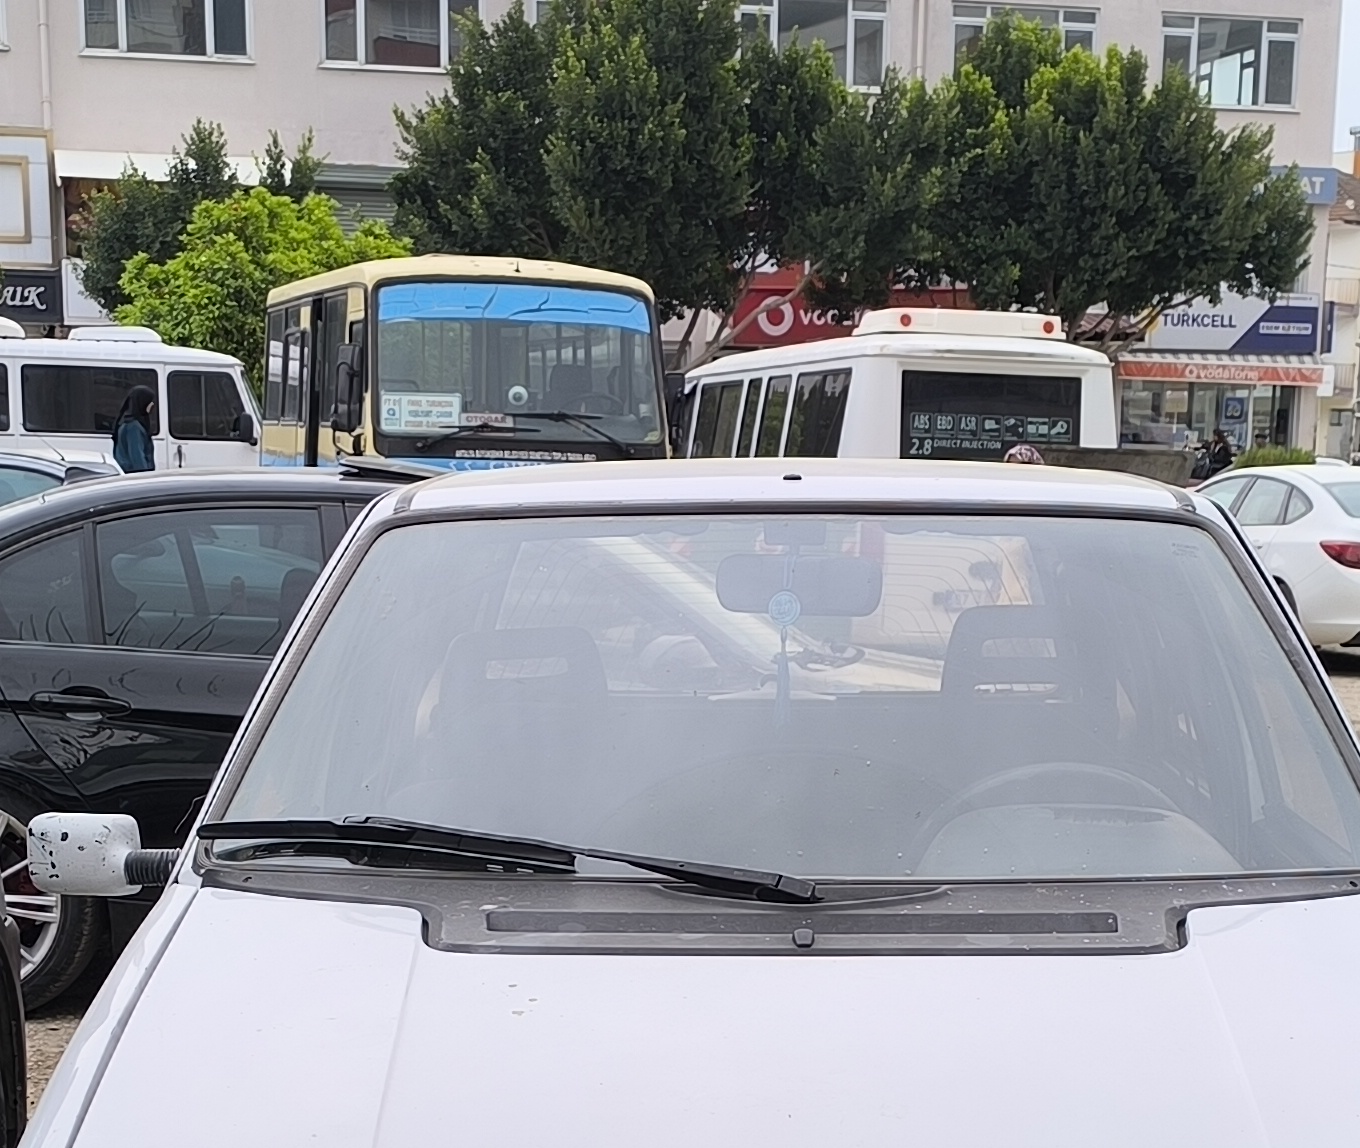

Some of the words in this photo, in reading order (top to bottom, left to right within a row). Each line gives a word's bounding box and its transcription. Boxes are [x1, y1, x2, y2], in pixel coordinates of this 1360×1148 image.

[1161, 312, 1237, 328] TURKCELL
[913, 414, 930, 429] ABS
[936, 415, 953, 430] EBD
[960, 416, 977, 431] ASR
[909, 439, 932, 455] 2.8
[934, 439, 960, 448] DIRECT
[961, 440, 1002, 449] INJECTION
